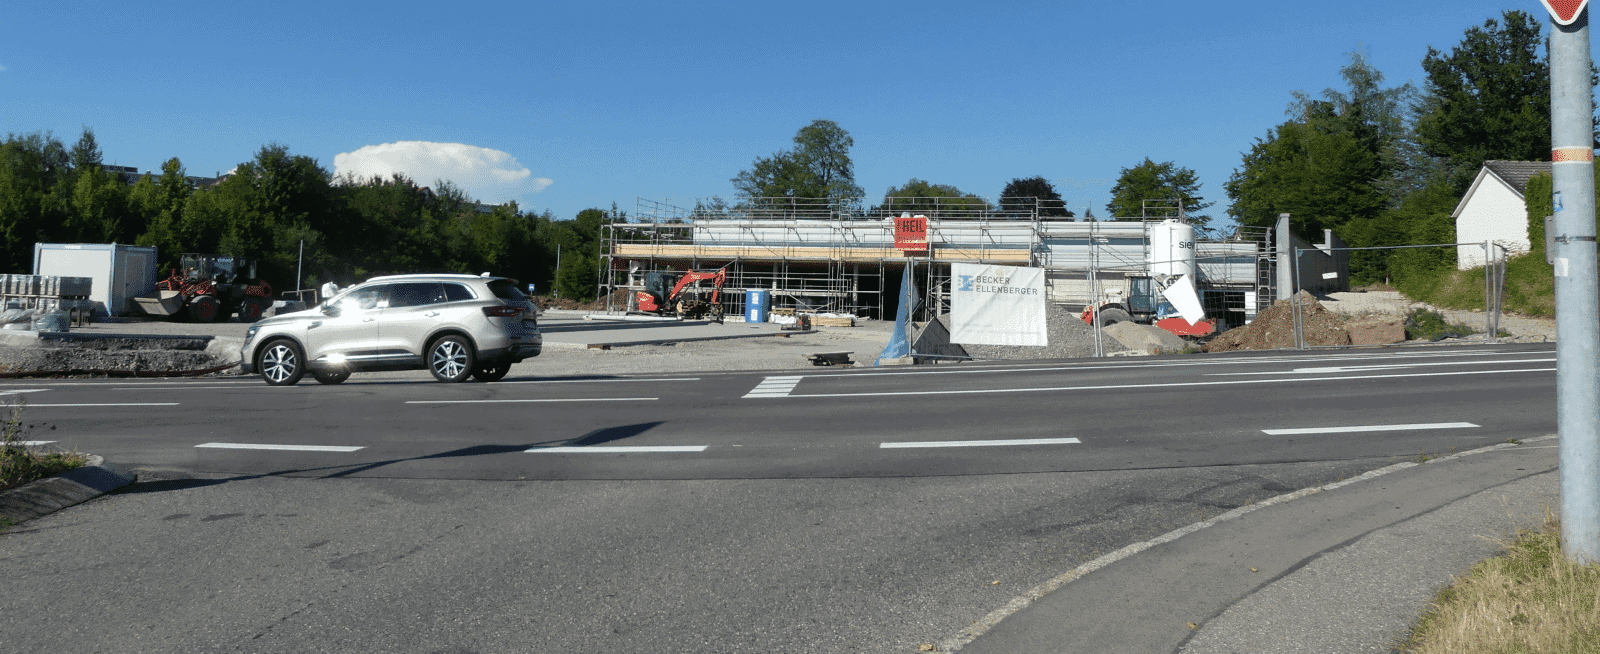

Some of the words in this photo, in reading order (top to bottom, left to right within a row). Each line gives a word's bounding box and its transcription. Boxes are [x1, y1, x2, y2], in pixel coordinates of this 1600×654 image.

[902, 219, 925, 233] HEIL
[976, 275, 1010, 285] BECKER
[976, 285, 1038, 295] ELLENBERGER
